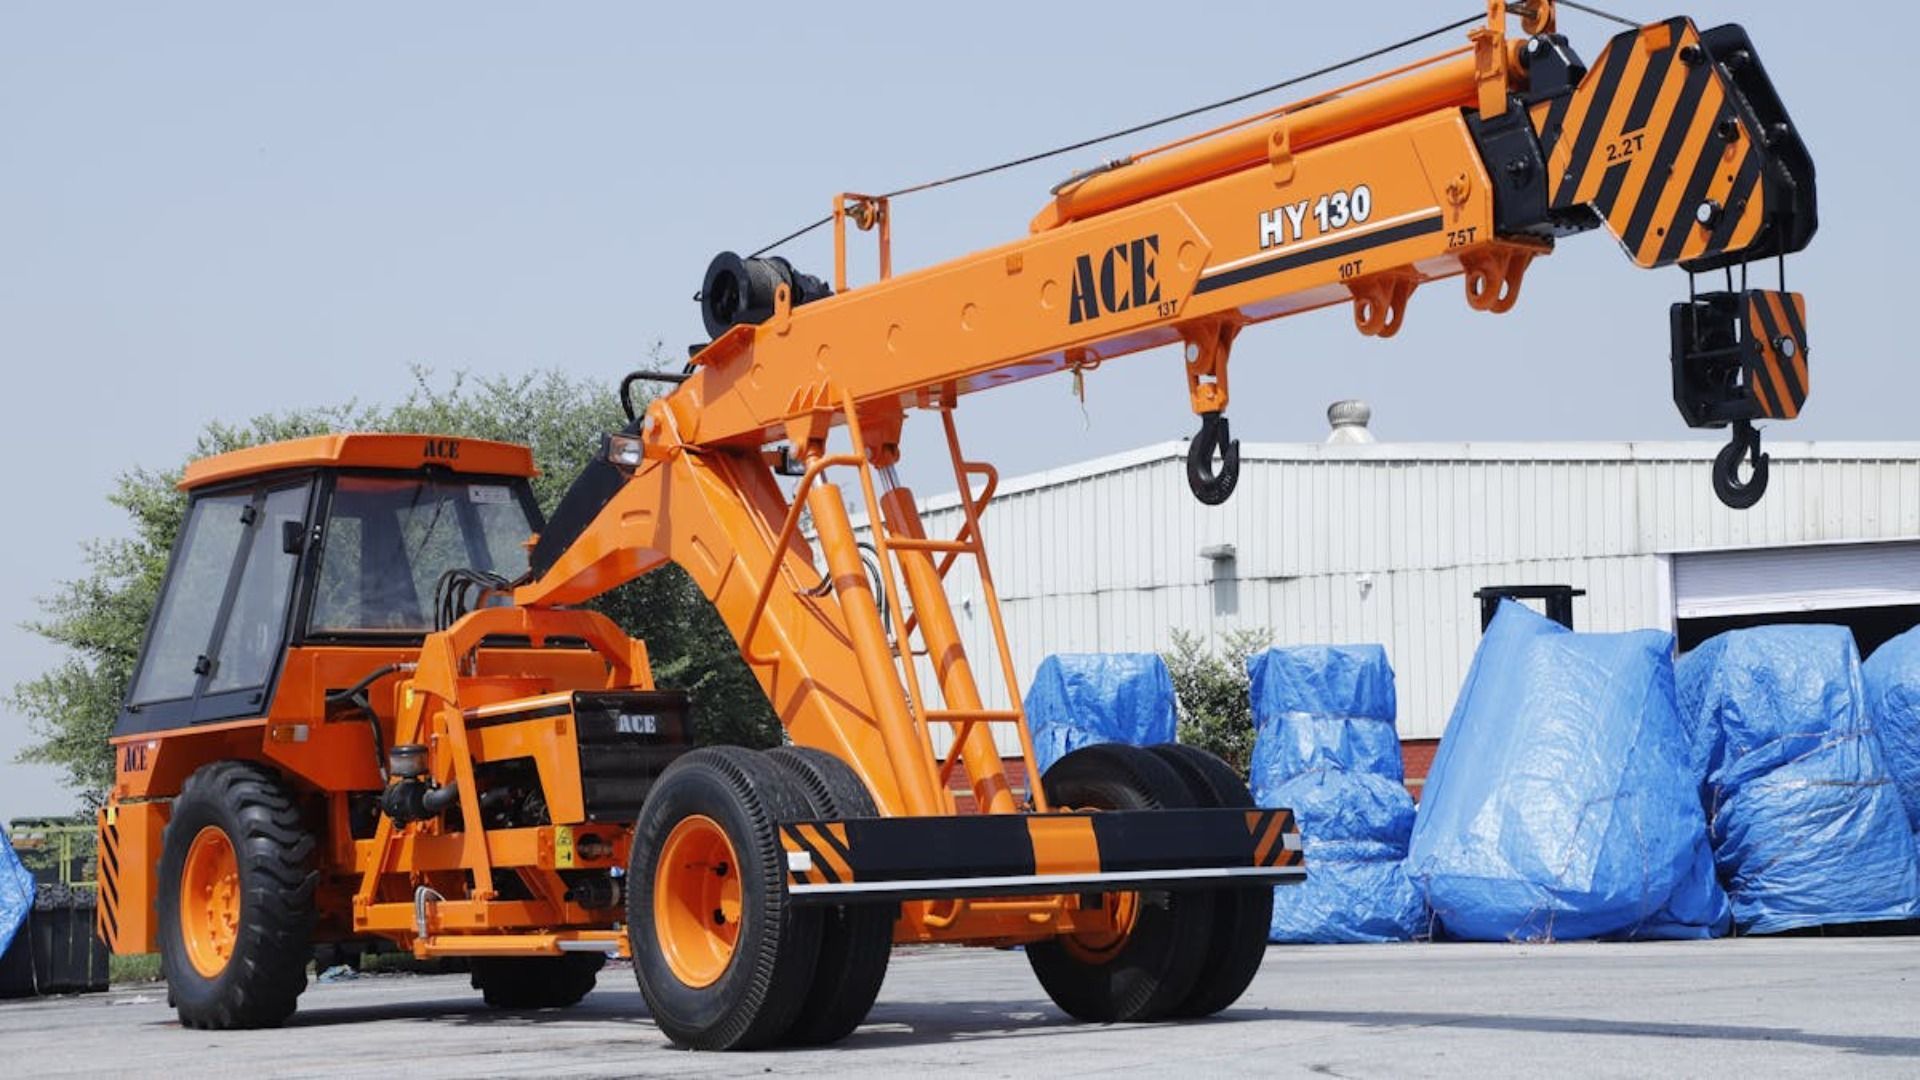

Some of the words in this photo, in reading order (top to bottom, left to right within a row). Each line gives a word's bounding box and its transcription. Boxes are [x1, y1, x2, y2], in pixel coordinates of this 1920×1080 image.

[1606, 134, 1644, 161] 2.2T
[1260, 199, 1309, 249] HY
[1313, 184, 1371, 232] 130
[1069, 234, 1160, 325] ACE
[1338, 259, 1362, 279] 10T
[1157, 299, 1178, 317] 13T
[424, 440, 459, 459] ACE
[616, 714, 656, 733] ACE
[124, 745, 147, 772] ACE
